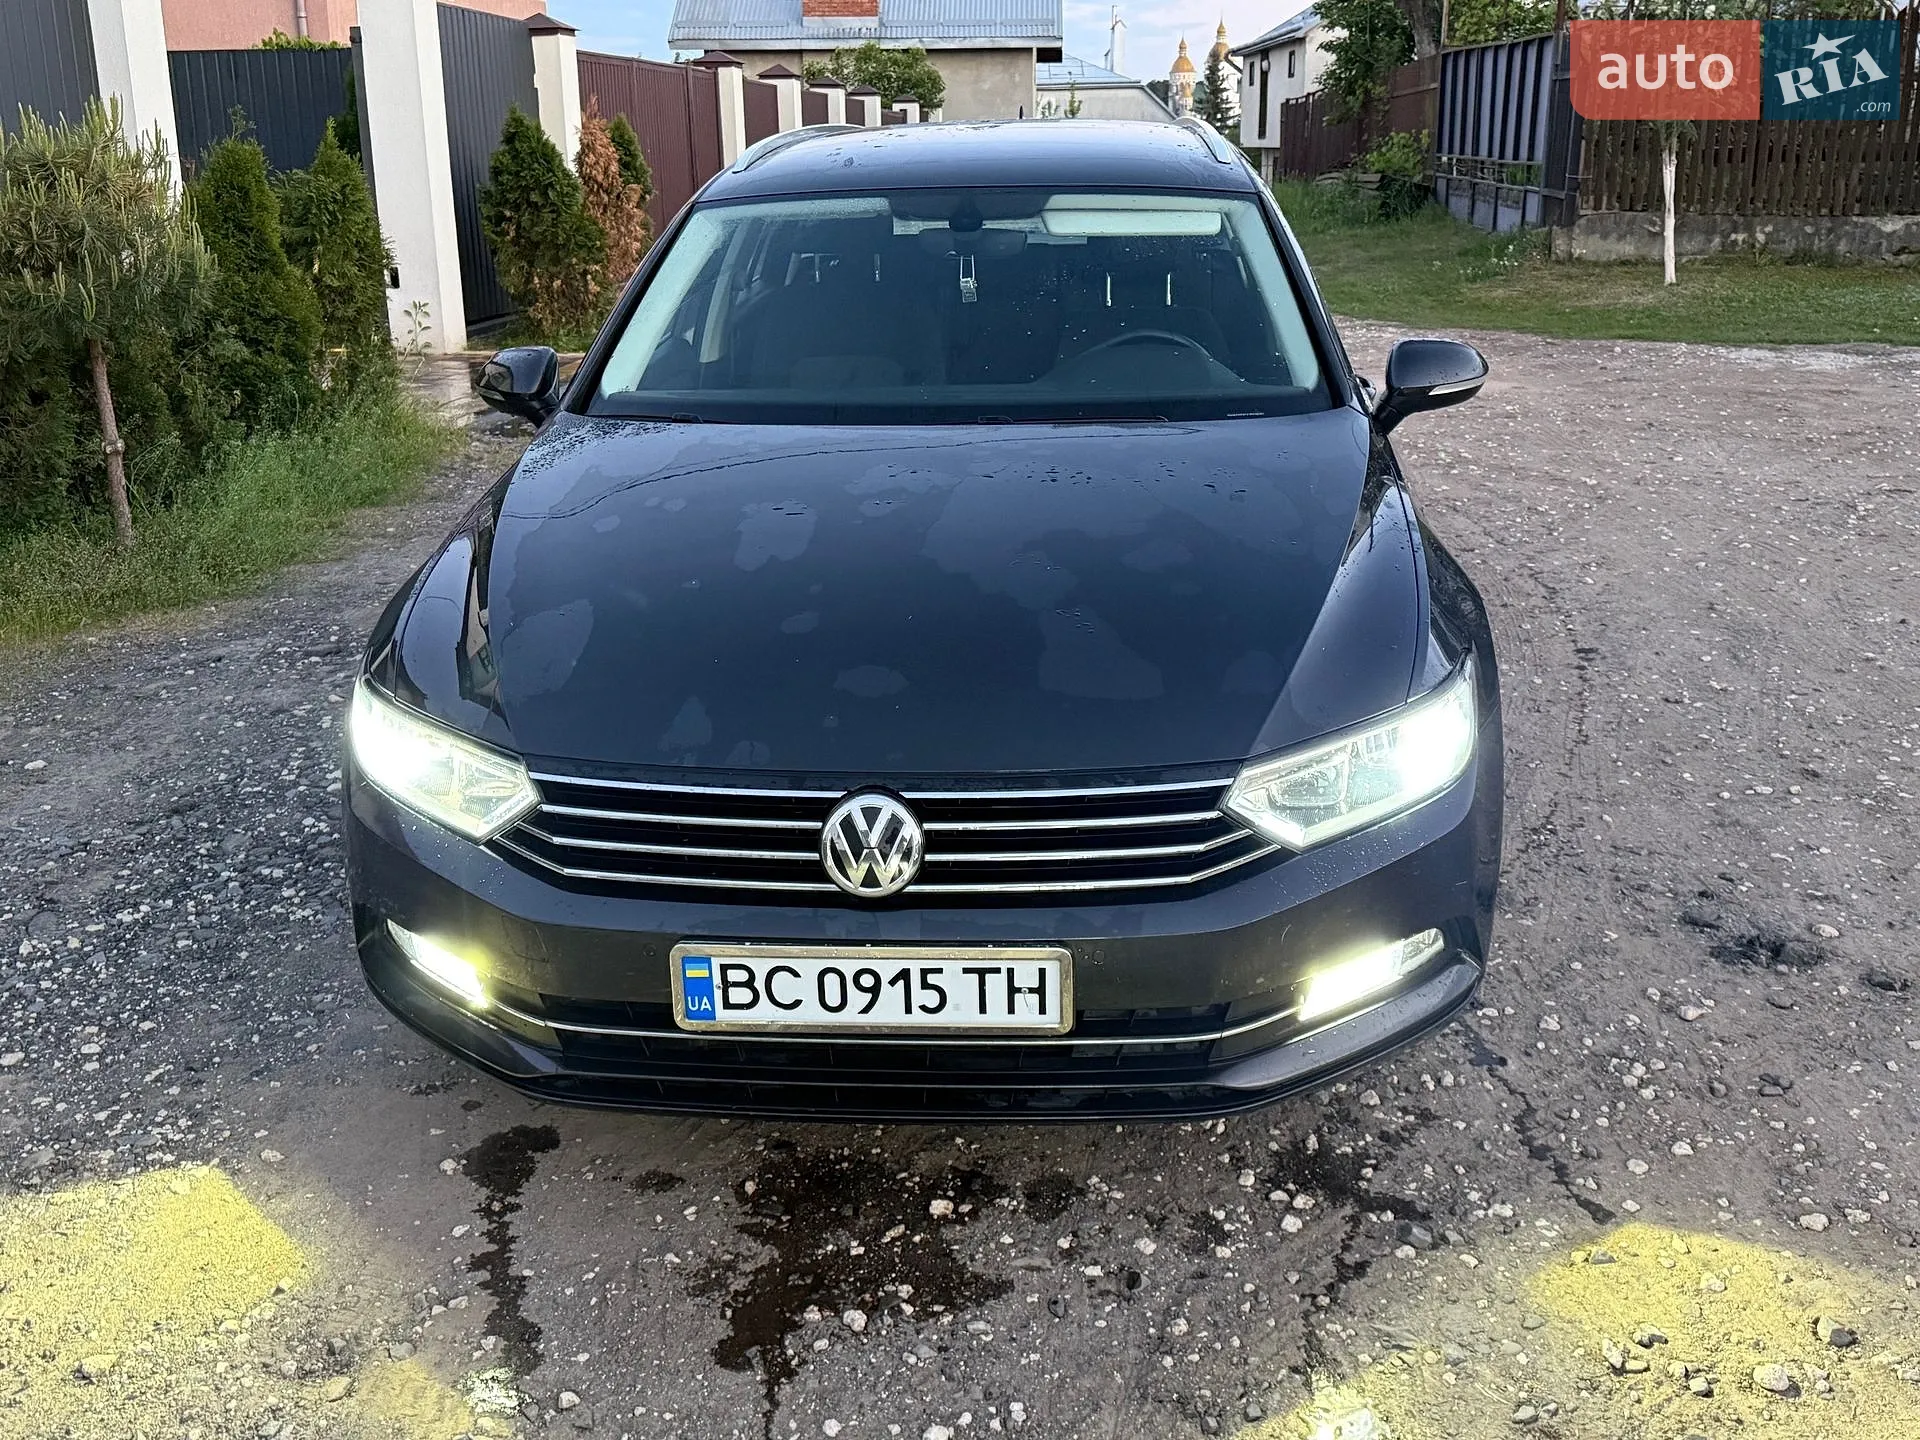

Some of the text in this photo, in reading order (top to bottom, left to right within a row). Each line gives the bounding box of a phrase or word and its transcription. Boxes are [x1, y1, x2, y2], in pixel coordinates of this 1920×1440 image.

[687, 996, 713, 1011] UA
[719, 963, 1047, 1016] BC 0915 TH
